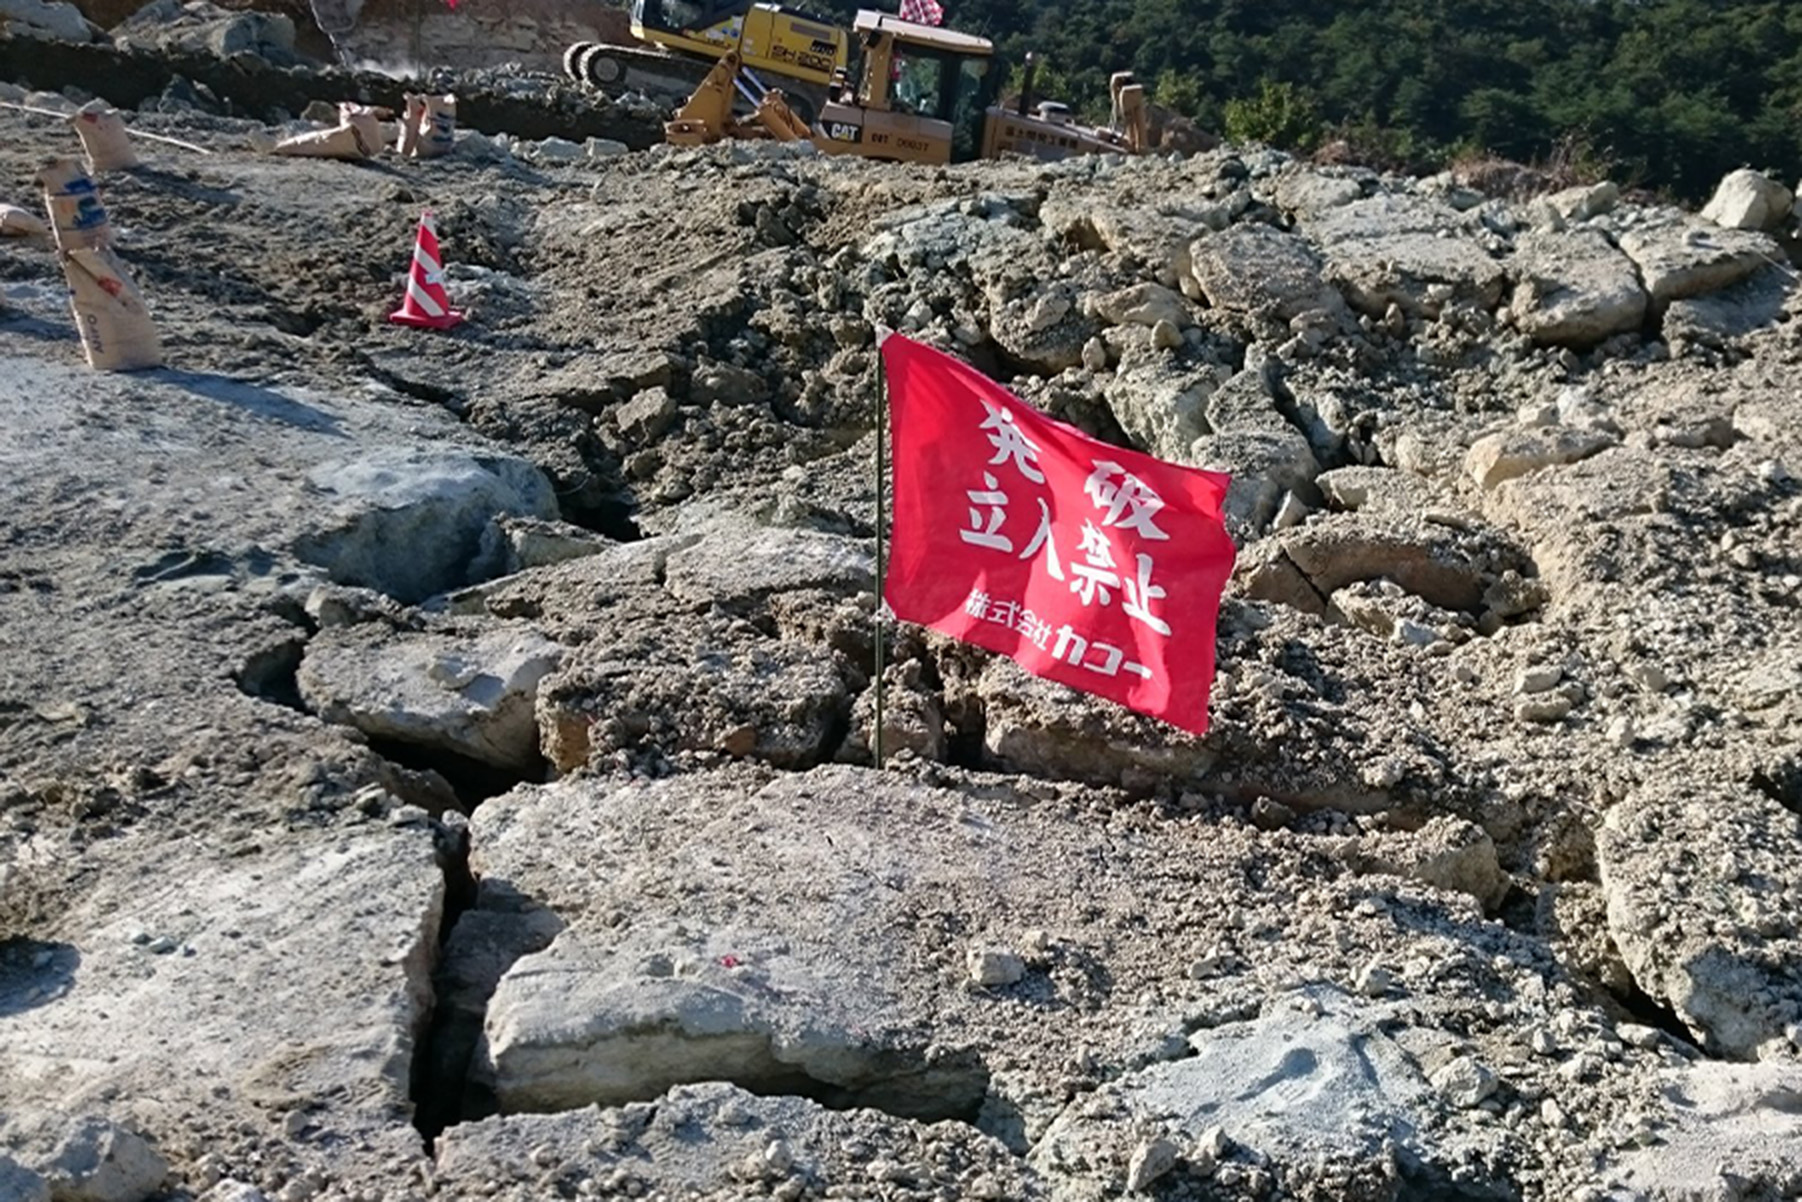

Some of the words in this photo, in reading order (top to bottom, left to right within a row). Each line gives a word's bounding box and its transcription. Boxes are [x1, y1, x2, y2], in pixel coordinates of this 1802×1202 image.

[831, 123, 859, 140] CAT
[960, 471, 1171, 636] 立入禁止
